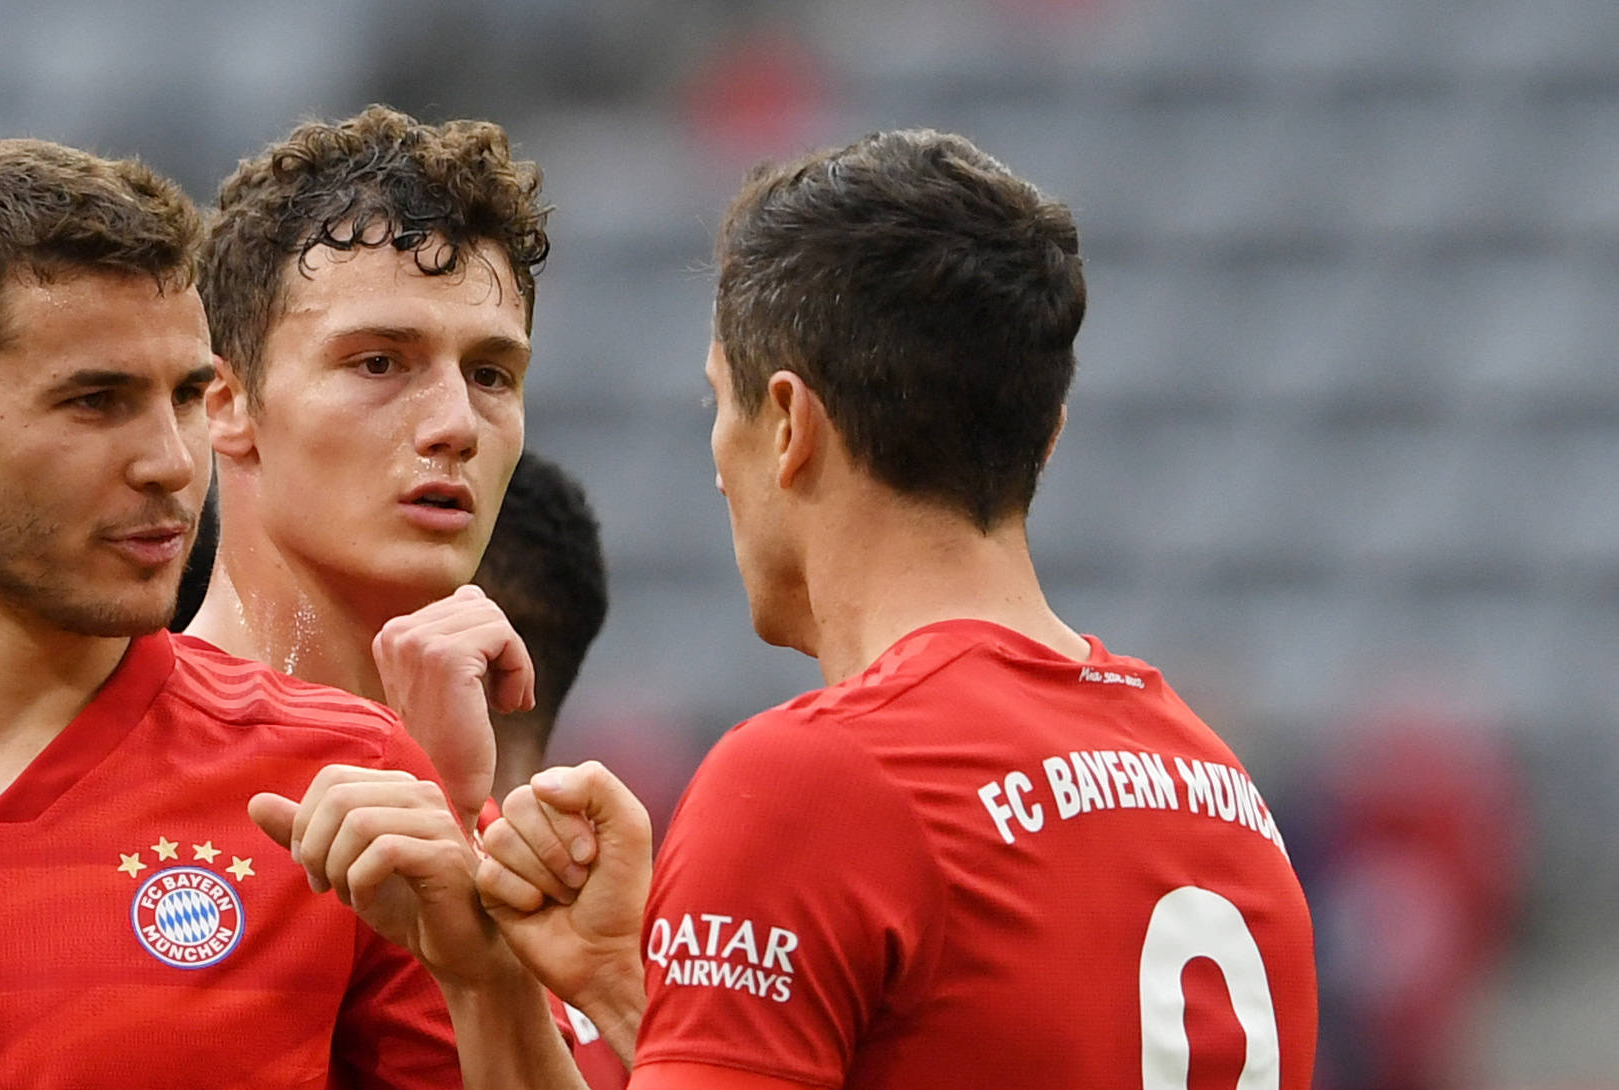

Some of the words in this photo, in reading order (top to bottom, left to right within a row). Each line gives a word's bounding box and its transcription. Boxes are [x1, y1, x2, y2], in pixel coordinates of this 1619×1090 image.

[977, 771, 1044, 844] FC
[1042, 750, 1179, 820] BAYERN
[141, 886, 163, 910] FC
[162, 874, 234, 912] BAYERN
[142, 925, 234, 961] MÜNCHEN
[647, 913, 798, 973] QATAR
[665, 959, 792, 1003] AIRWAYS
